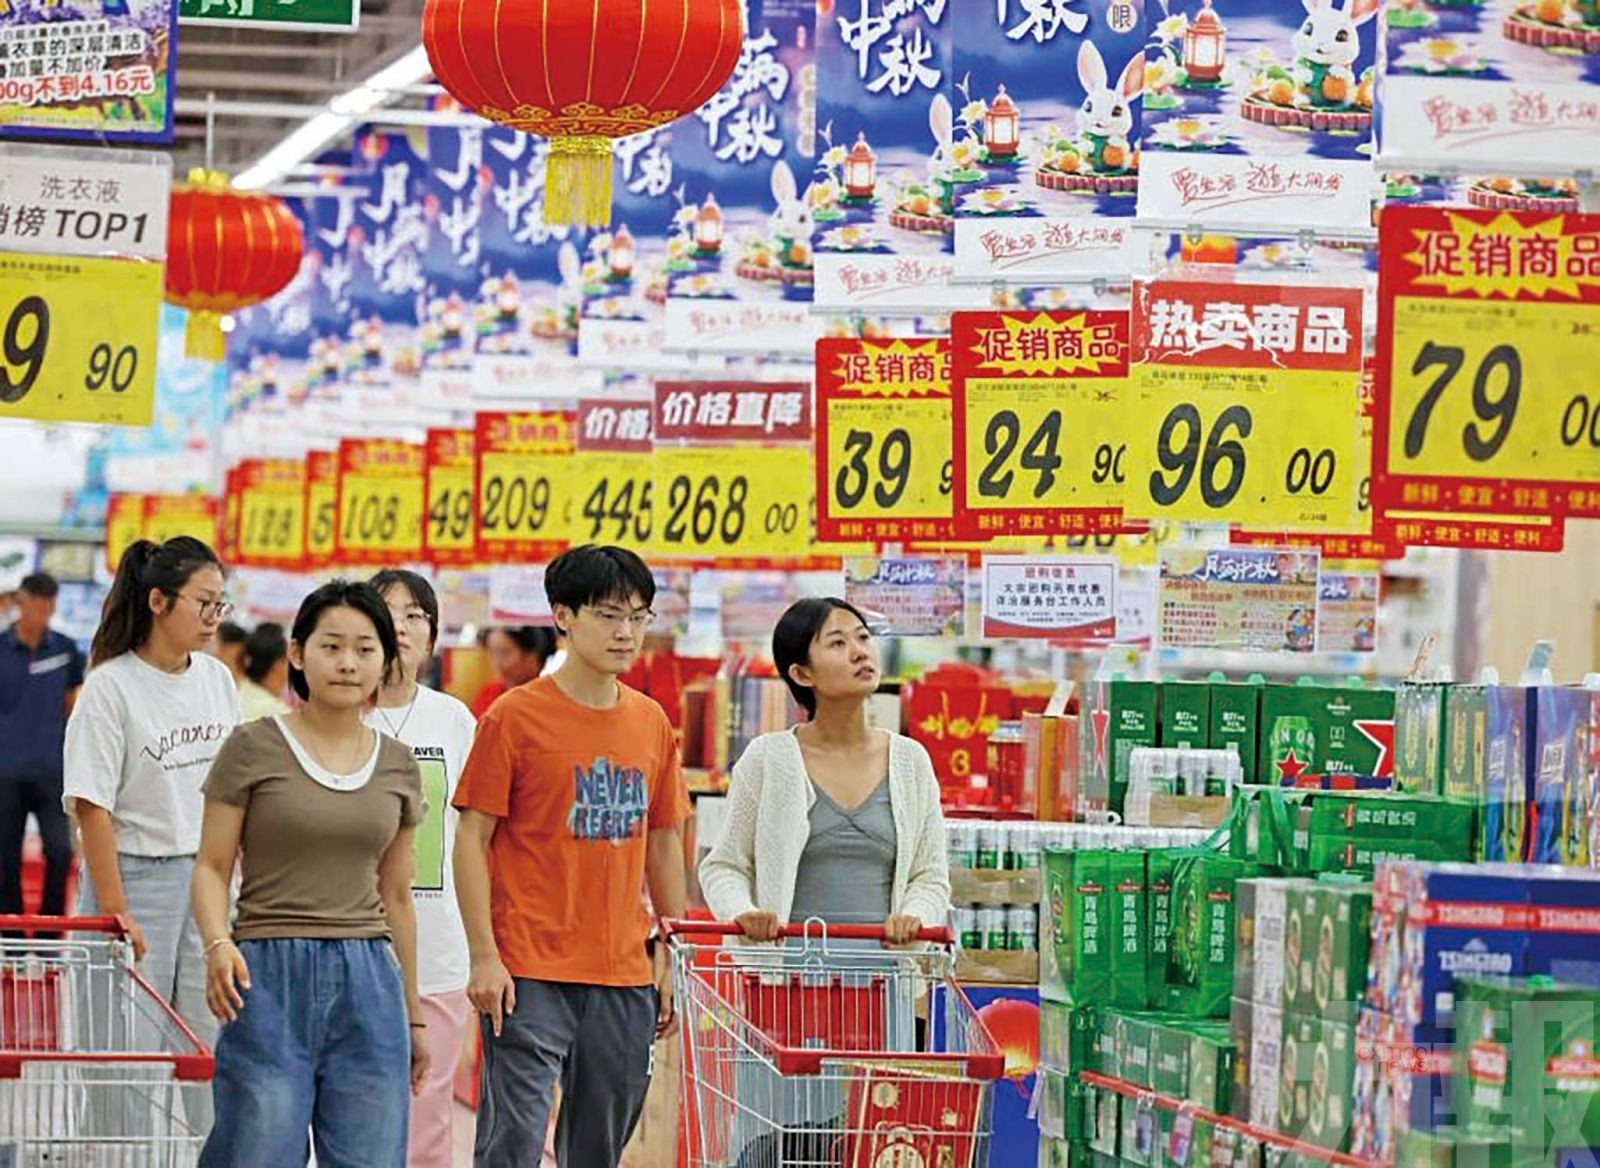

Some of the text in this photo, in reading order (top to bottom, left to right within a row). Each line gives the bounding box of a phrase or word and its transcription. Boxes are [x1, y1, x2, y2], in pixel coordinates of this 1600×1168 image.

[40, 173, 120, 203] 洗衣液
[55, 209, 148, 243] TOP1
[1419, 232, 1600, 279] 促销商品
[981, 326, 1120, 362] 促销商品
[1149, 298, 1348, 354] 热卖商品
[662, 391, 802, 433] 价格直降
[430, 490, 470, 539] 49
[483, 477, 550, 531] 209
[664, 475, 797, 544] 268 00
[574, 764, 645, 805] NEVER
